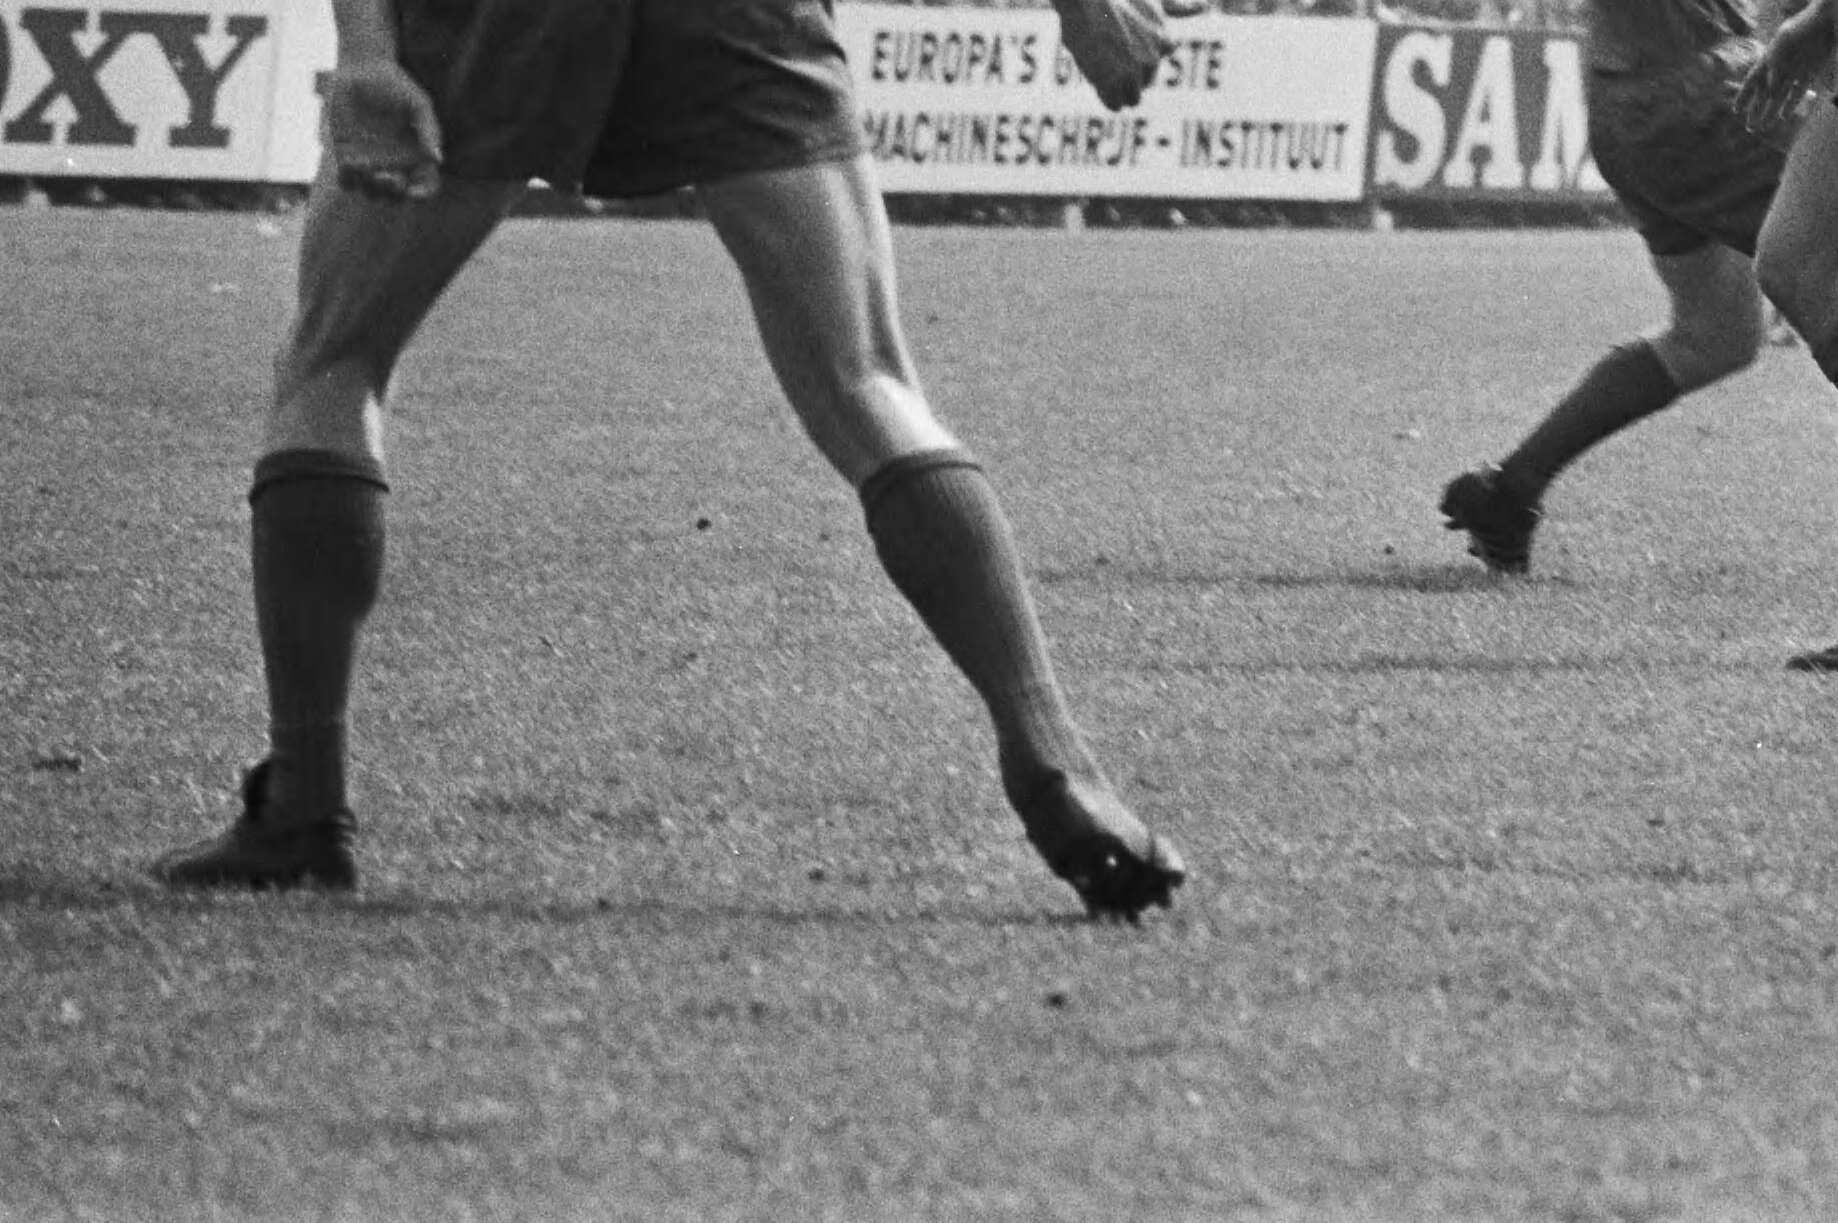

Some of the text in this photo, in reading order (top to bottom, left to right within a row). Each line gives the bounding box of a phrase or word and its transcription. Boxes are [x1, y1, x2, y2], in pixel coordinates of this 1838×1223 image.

[0, 8, 268, 149] XY
[871, 31, 1038, 85] EUROPA'S
[1180, 118, 1349, 171] INSTITUUT
[1374, 30, 1612, 192] SAM
